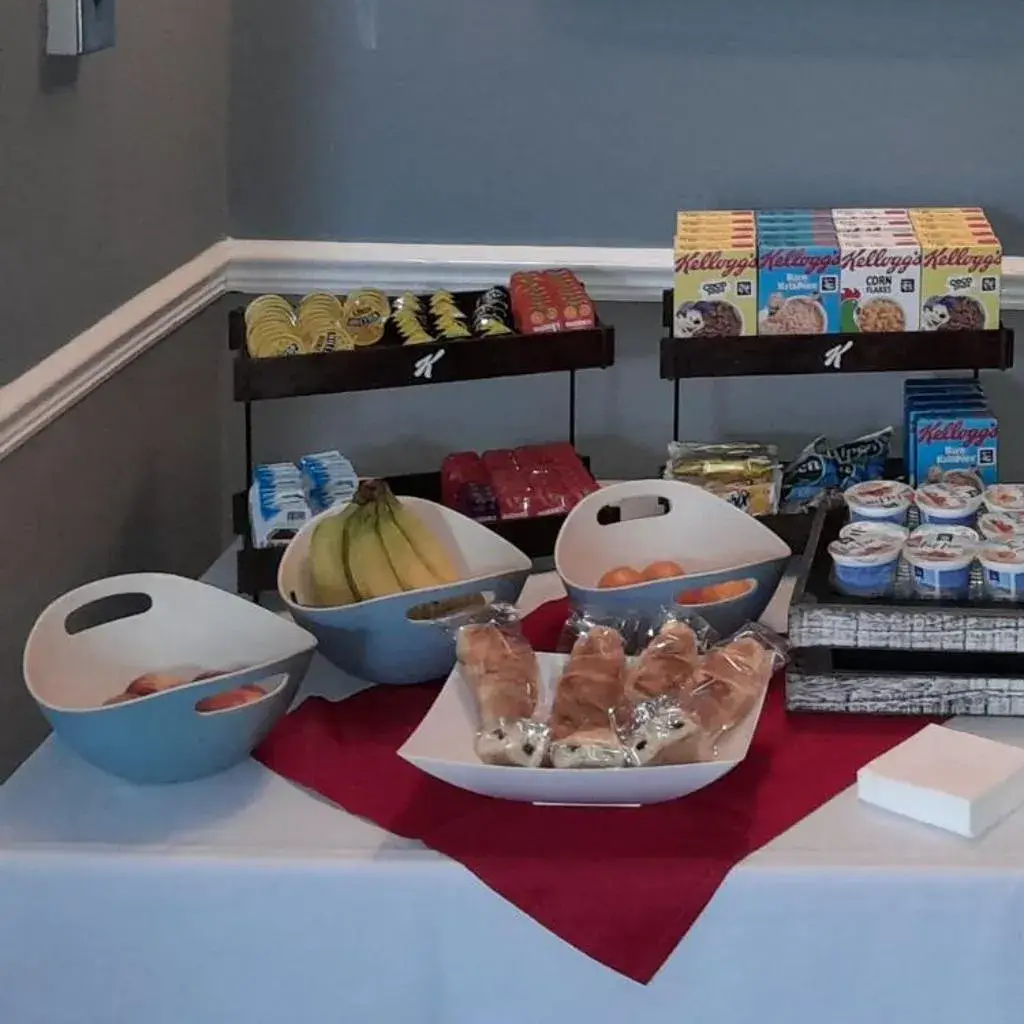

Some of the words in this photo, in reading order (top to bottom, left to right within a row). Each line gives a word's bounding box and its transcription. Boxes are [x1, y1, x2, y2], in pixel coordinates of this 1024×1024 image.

[675, 251, 757, 276] Kellogg's
[758, 249, 841, 275] Kellogg's
[841, 248, 922, 273] Kellogg's
[923, 247, 1002, 272] Kellogg's
[866, 276, 892, 286] CORN
[917, 420, 999, 447] Kellogg's
